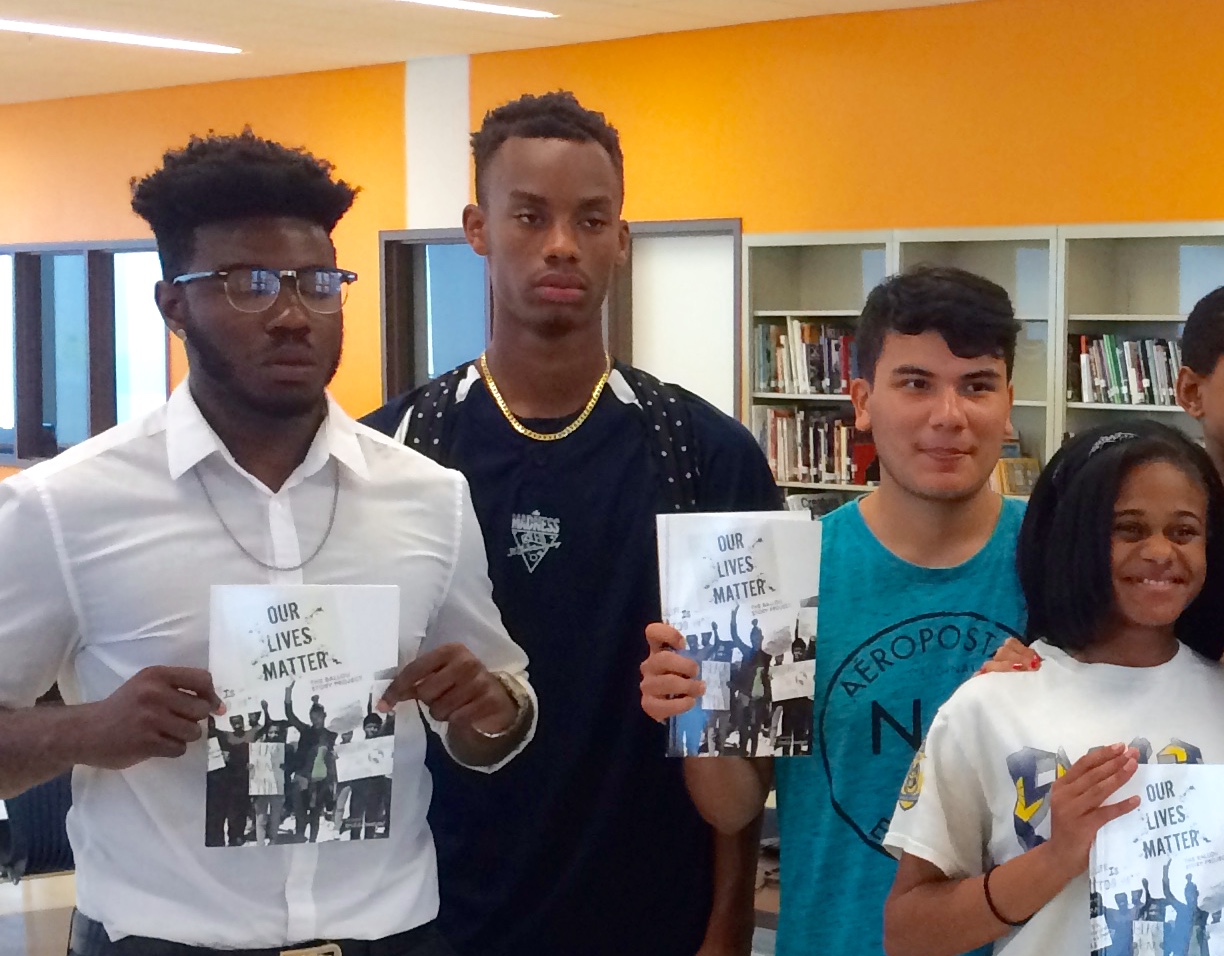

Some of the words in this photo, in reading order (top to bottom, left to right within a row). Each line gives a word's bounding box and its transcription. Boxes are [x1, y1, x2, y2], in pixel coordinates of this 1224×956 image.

[717, 532, 744, 552] OUR
[717, 555, 754, 579] LIVES
[713, 578, 766, 605] MATTER
[267, 601, 300, 624] OUR
[267, 626, 313, 652] LIVES
[262, 651, 329, 681] MATTER
[1146, 780, 1175, 802] OUR
[1146, 805, 1185, 831] LIVES
[1142, 829, 1200, 859] MATTER
